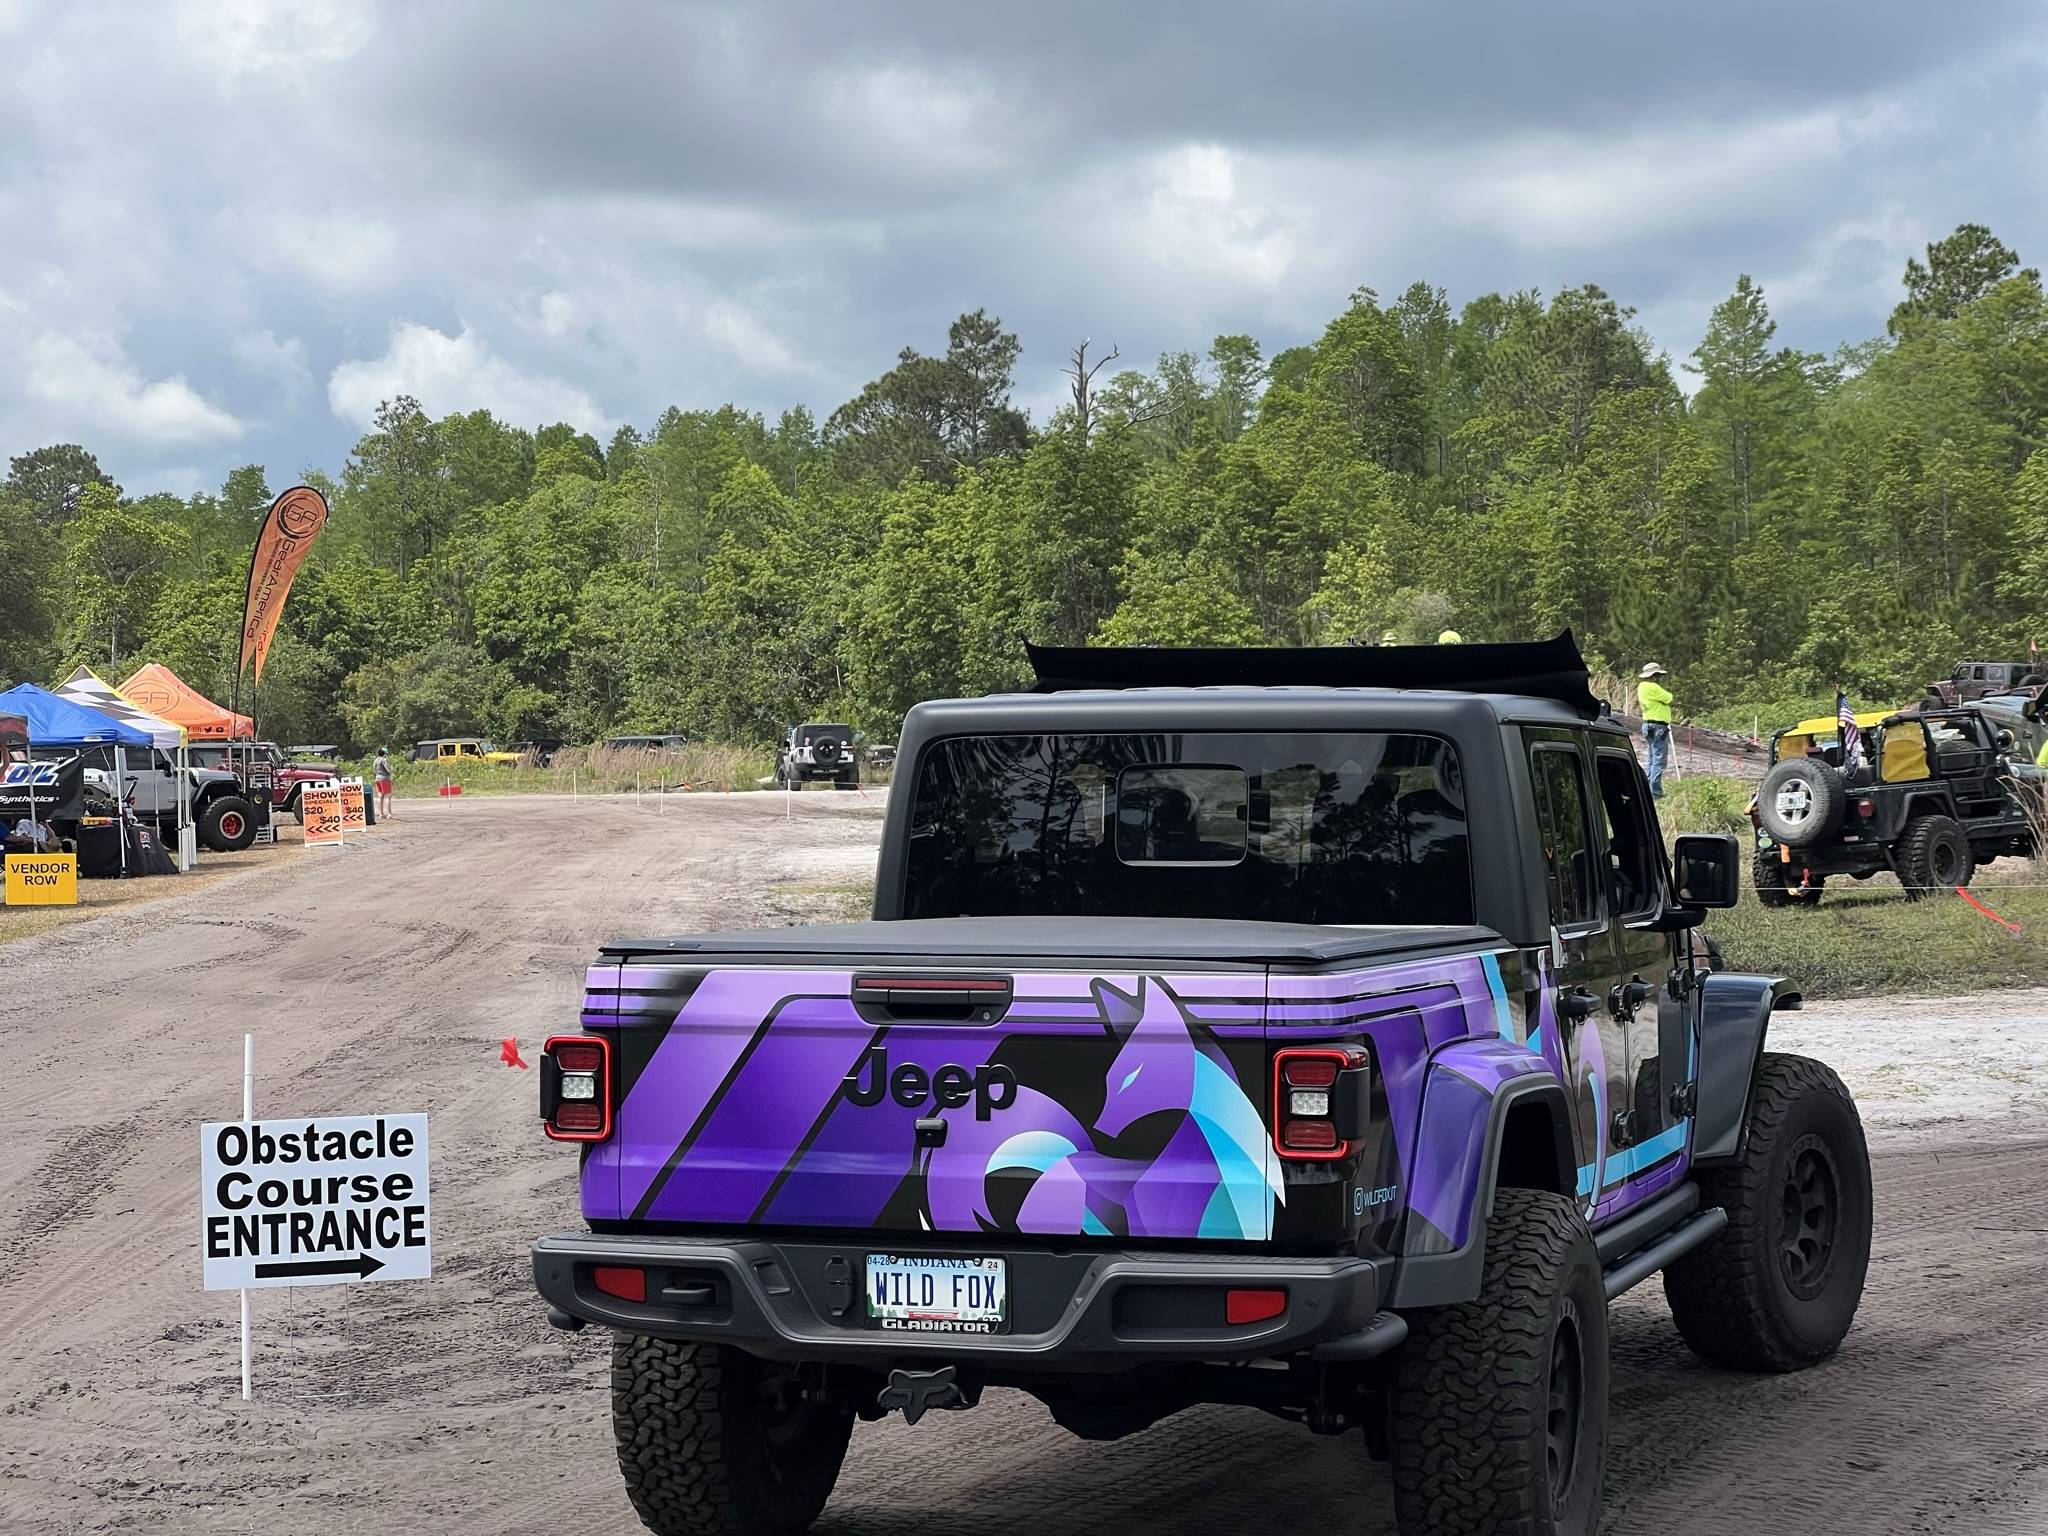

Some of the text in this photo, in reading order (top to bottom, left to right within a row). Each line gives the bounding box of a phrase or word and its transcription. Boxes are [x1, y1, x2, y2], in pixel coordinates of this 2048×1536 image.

[246, 539, 296, 639] GearAmerica
[304, 791, 339, 800] SHOW
[346, 806, 364, 814] $40
[320, 815, 341, 824] $40
[10, 863, 70, 874] VENDOR
[24, 875, 58, 886] ROW
[843, 1046, 1018, 1121] Jeep
[216, 1119, 414, 1166] Obstacle
[216, 1172, 413, 1210] Course
[207, 1205, 426, 1259] ENTRANCE
[903, 1257, 968, 1269] INDIANA
[987, 1261, 998, 1269] 24
[875, 1271, 935, 1307] WILD
[952, 1274, 996, 1309] FOX
[881, 1318, 990, 1333] GLADIATOR
